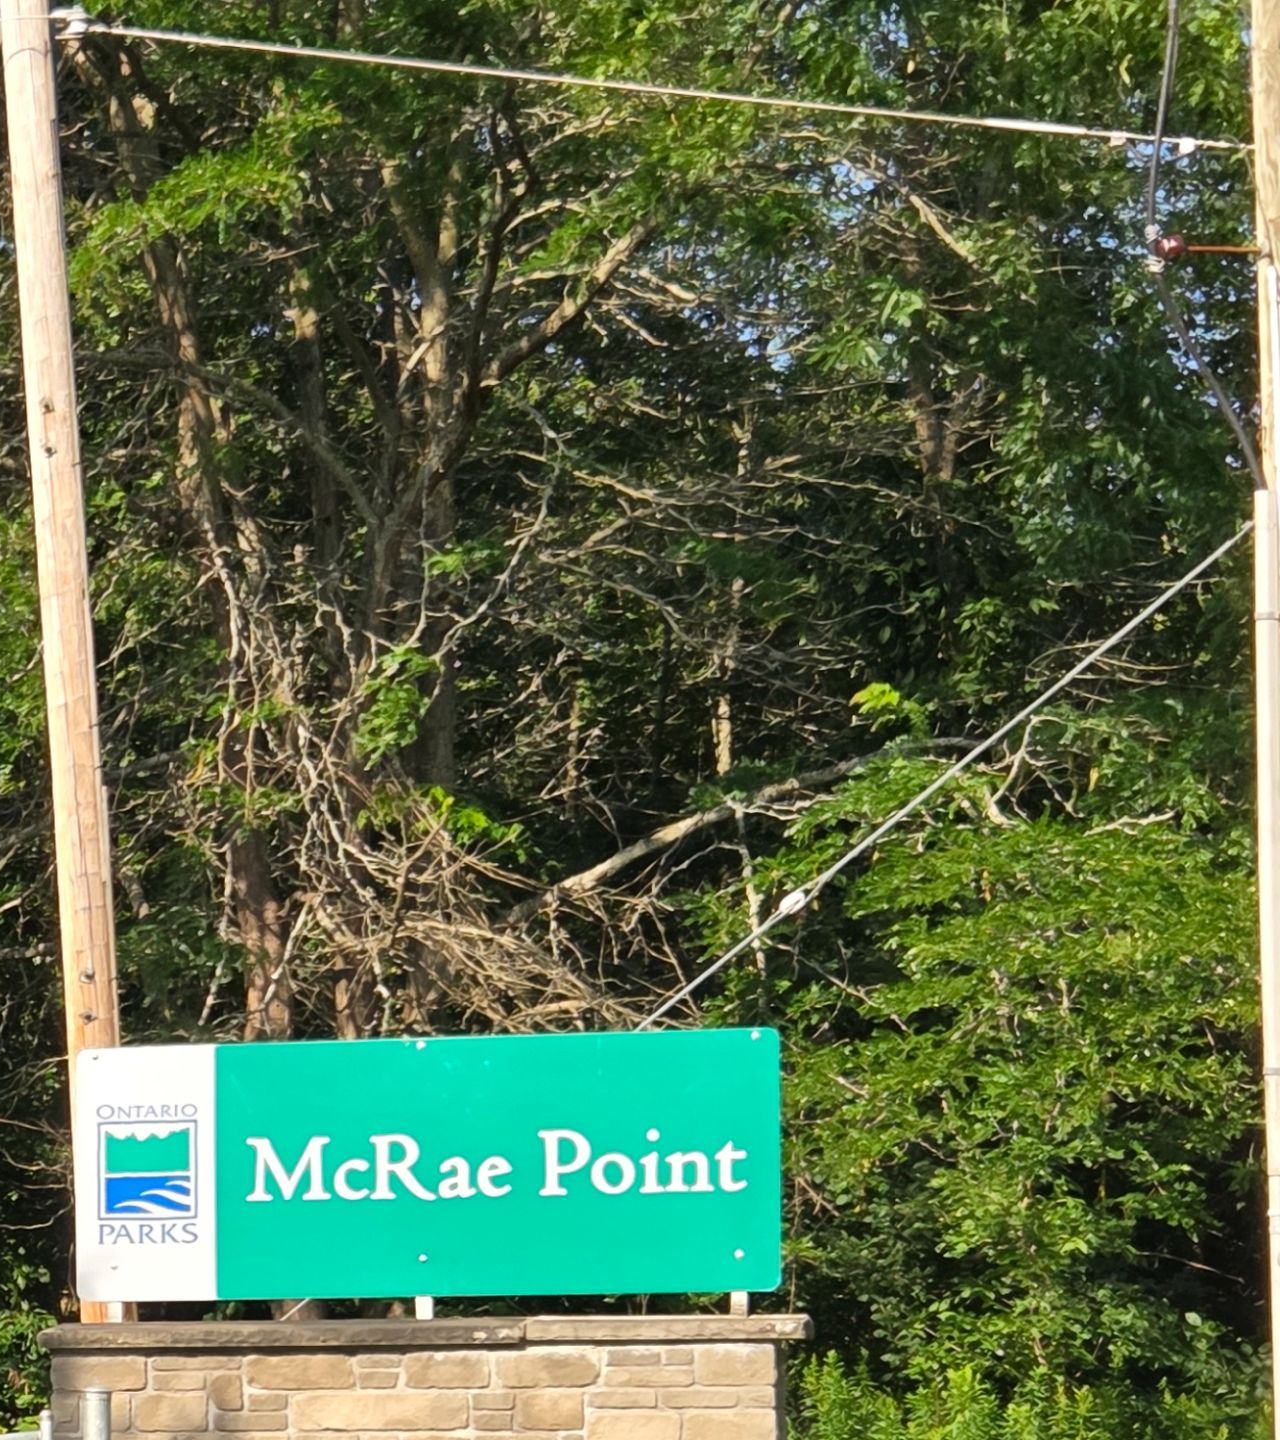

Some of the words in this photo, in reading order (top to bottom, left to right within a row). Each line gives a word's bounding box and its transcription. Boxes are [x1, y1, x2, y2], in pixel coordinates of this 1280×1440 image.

[96, 1103, 198, 1120] ONTARIO
[246, 1133, 512, 1202] McRae
[538, 1128, 747, 1196] Point
[98, 1223, 198, 1245] PARKS
